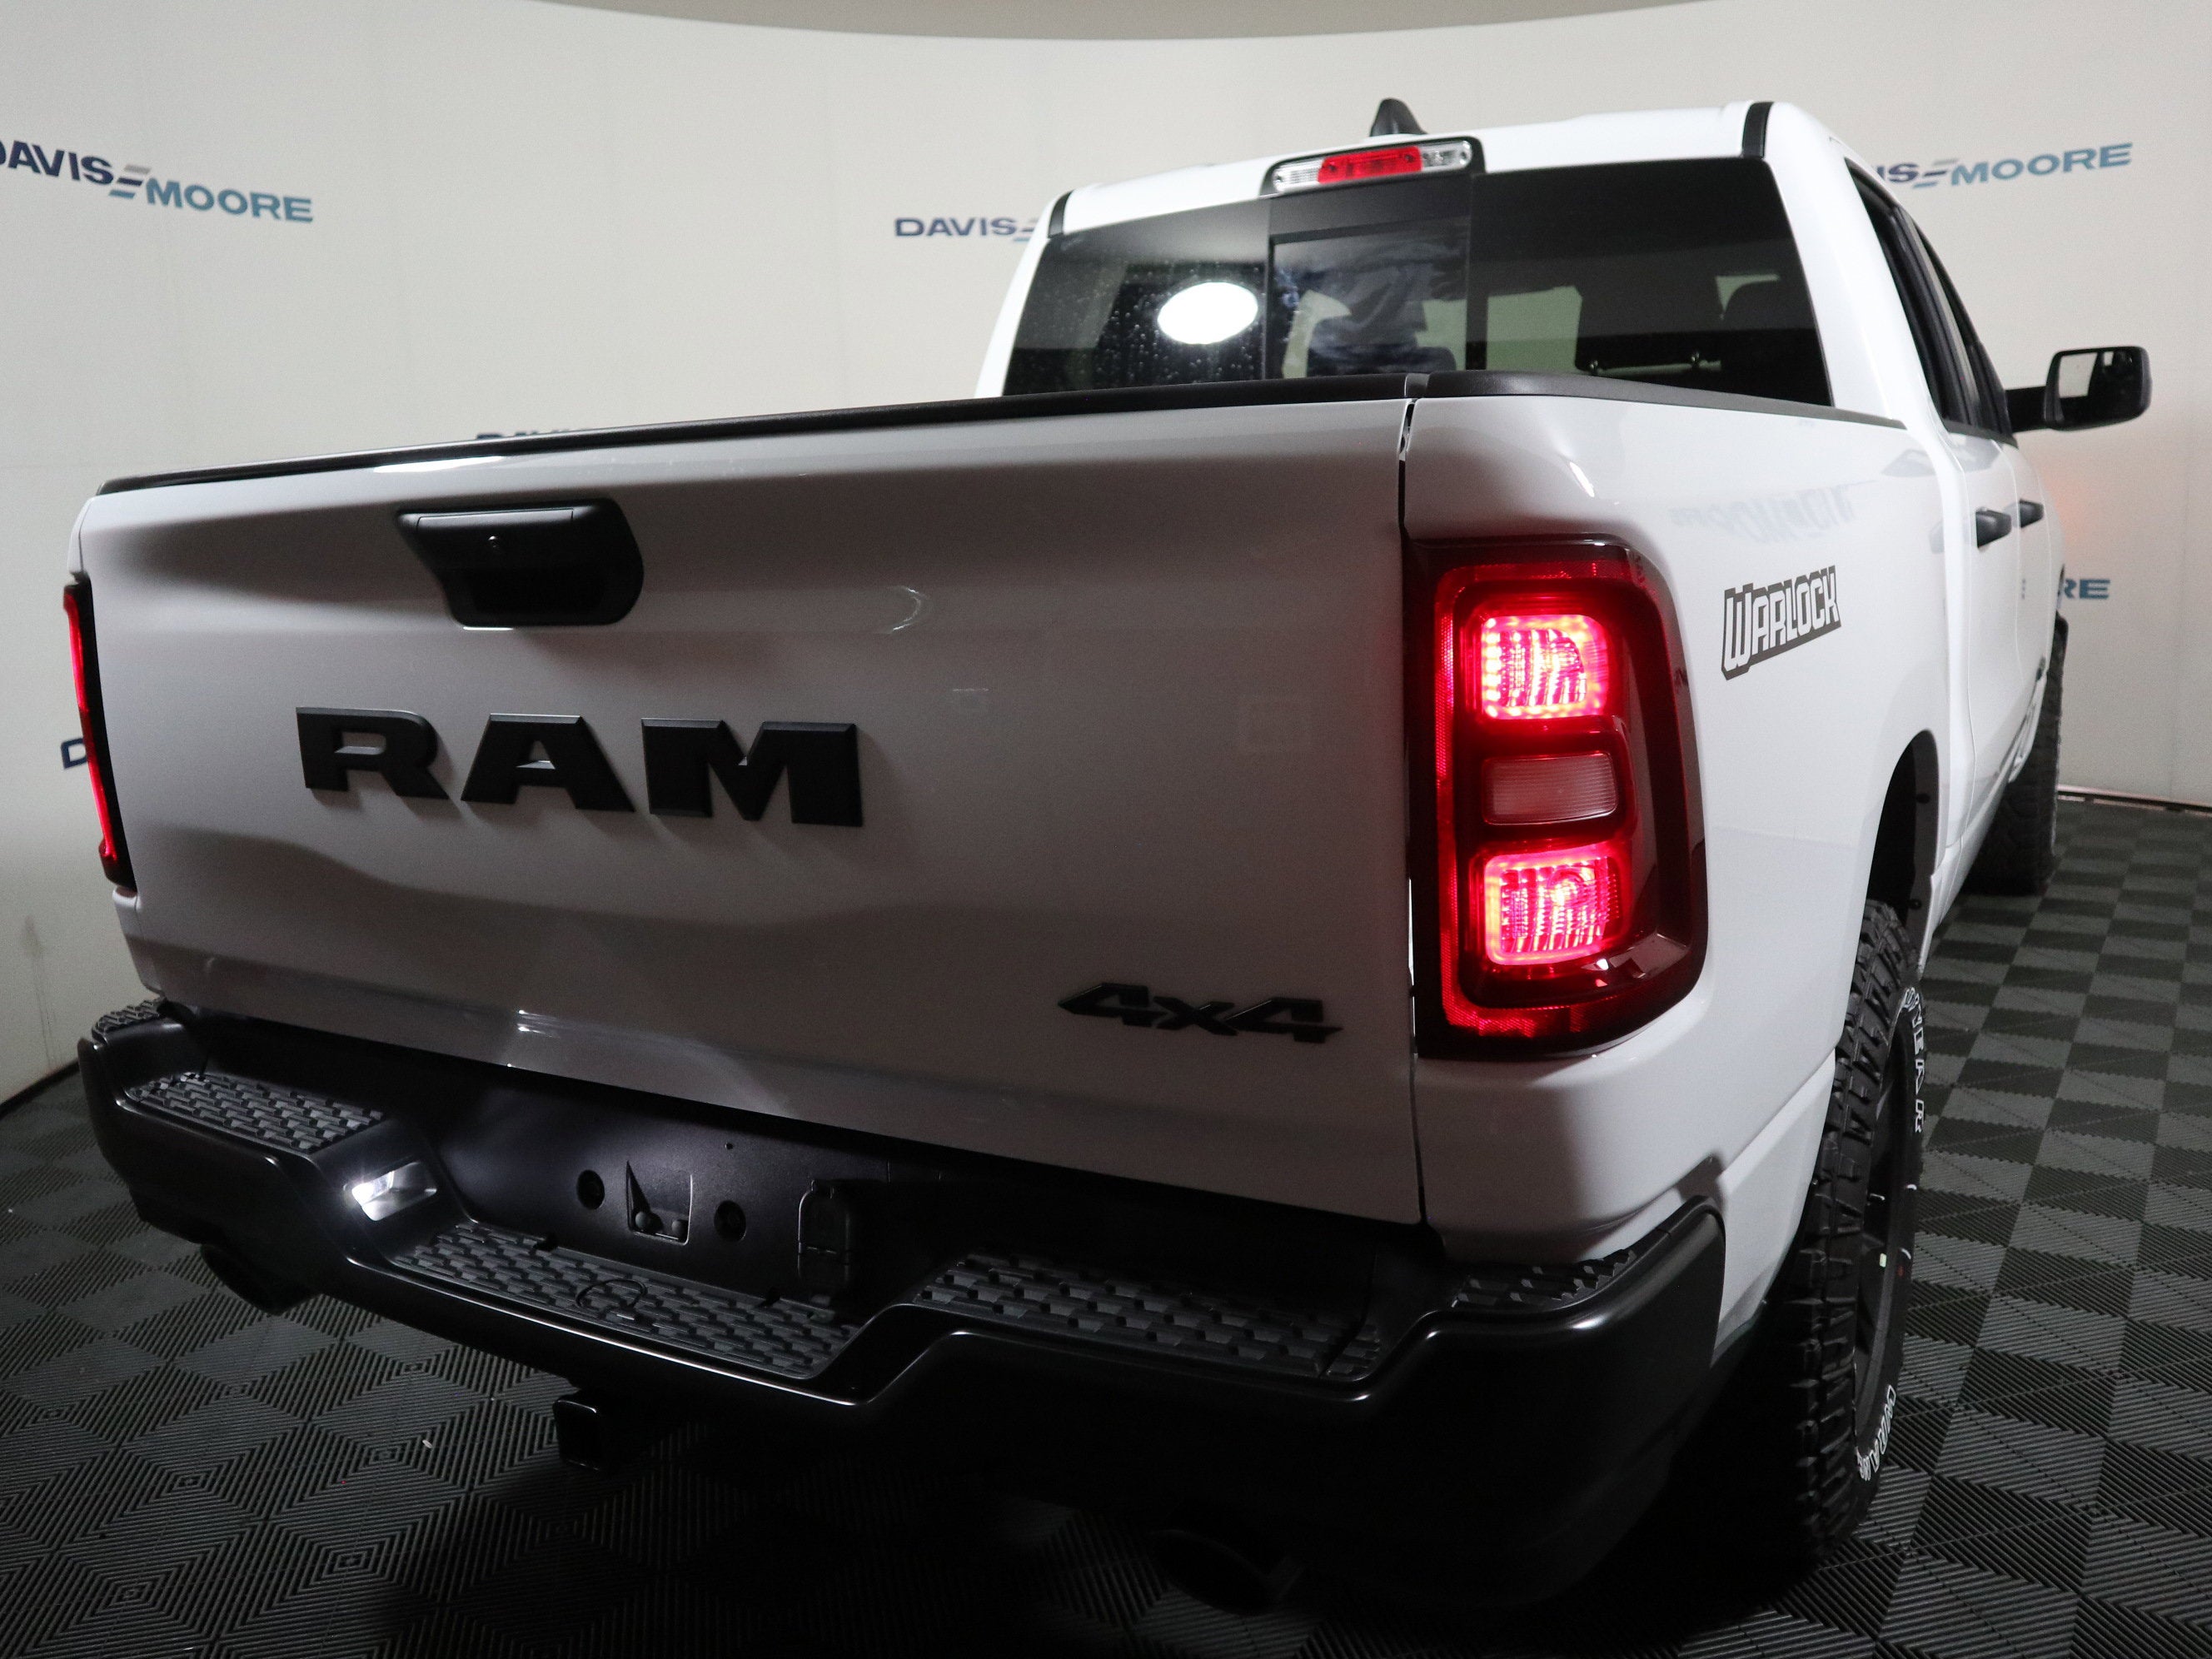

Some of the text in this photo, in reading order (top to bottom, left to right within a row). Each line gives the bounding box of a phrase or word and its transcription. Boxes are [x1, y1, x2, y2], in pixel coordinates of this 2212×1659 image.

[0, 140, 313, 223] AVIS MOORE
[1951, 142, 2133, 186] MOORE
[894, 217, 1017, 237] DAVIS
[1721, 565, 1841, 680] WARLOCK
[296, 706, 864, 827] RAM
